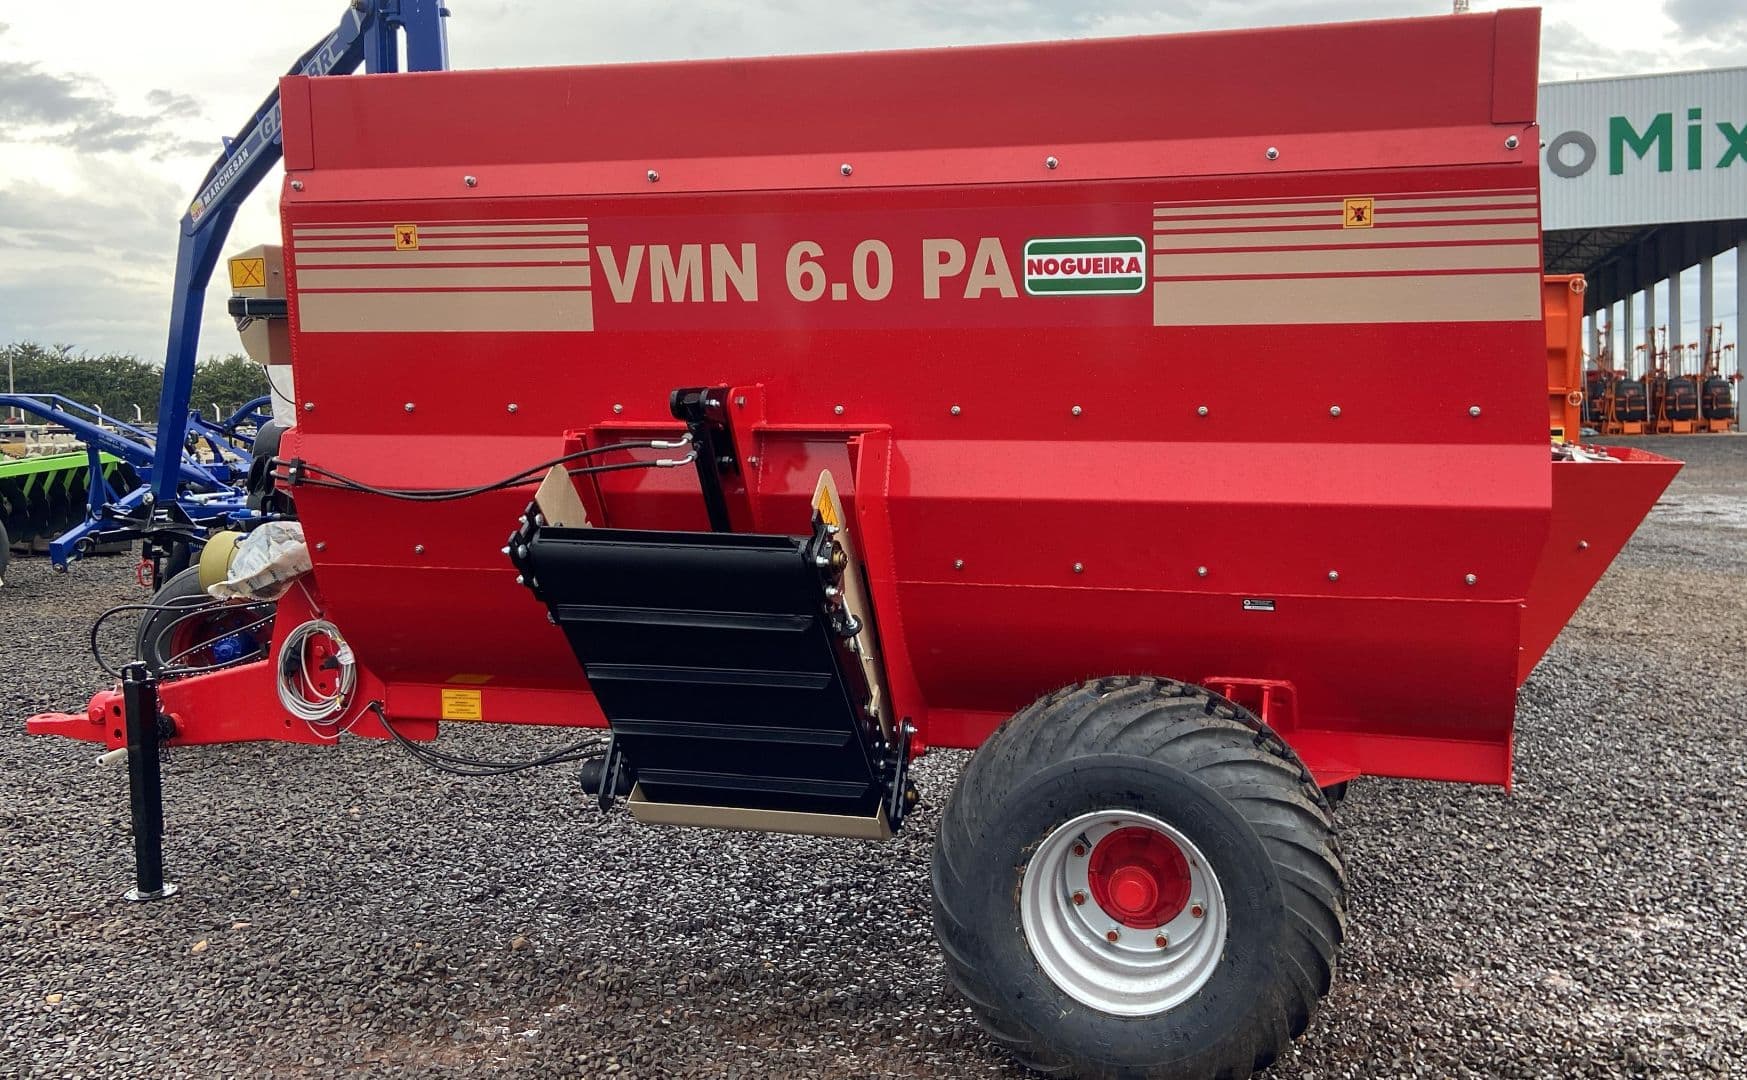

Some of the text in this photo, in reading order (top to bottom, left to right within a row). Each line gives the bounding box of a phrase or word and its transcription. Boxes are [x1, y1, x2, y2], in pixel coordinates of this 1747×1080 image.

[203, 147, 249, 206] MARCHESAN
[596, 237, 1019, 303] VMN 6.0 PA
[1028, 257, 1142, 275] NOGUEIRA
